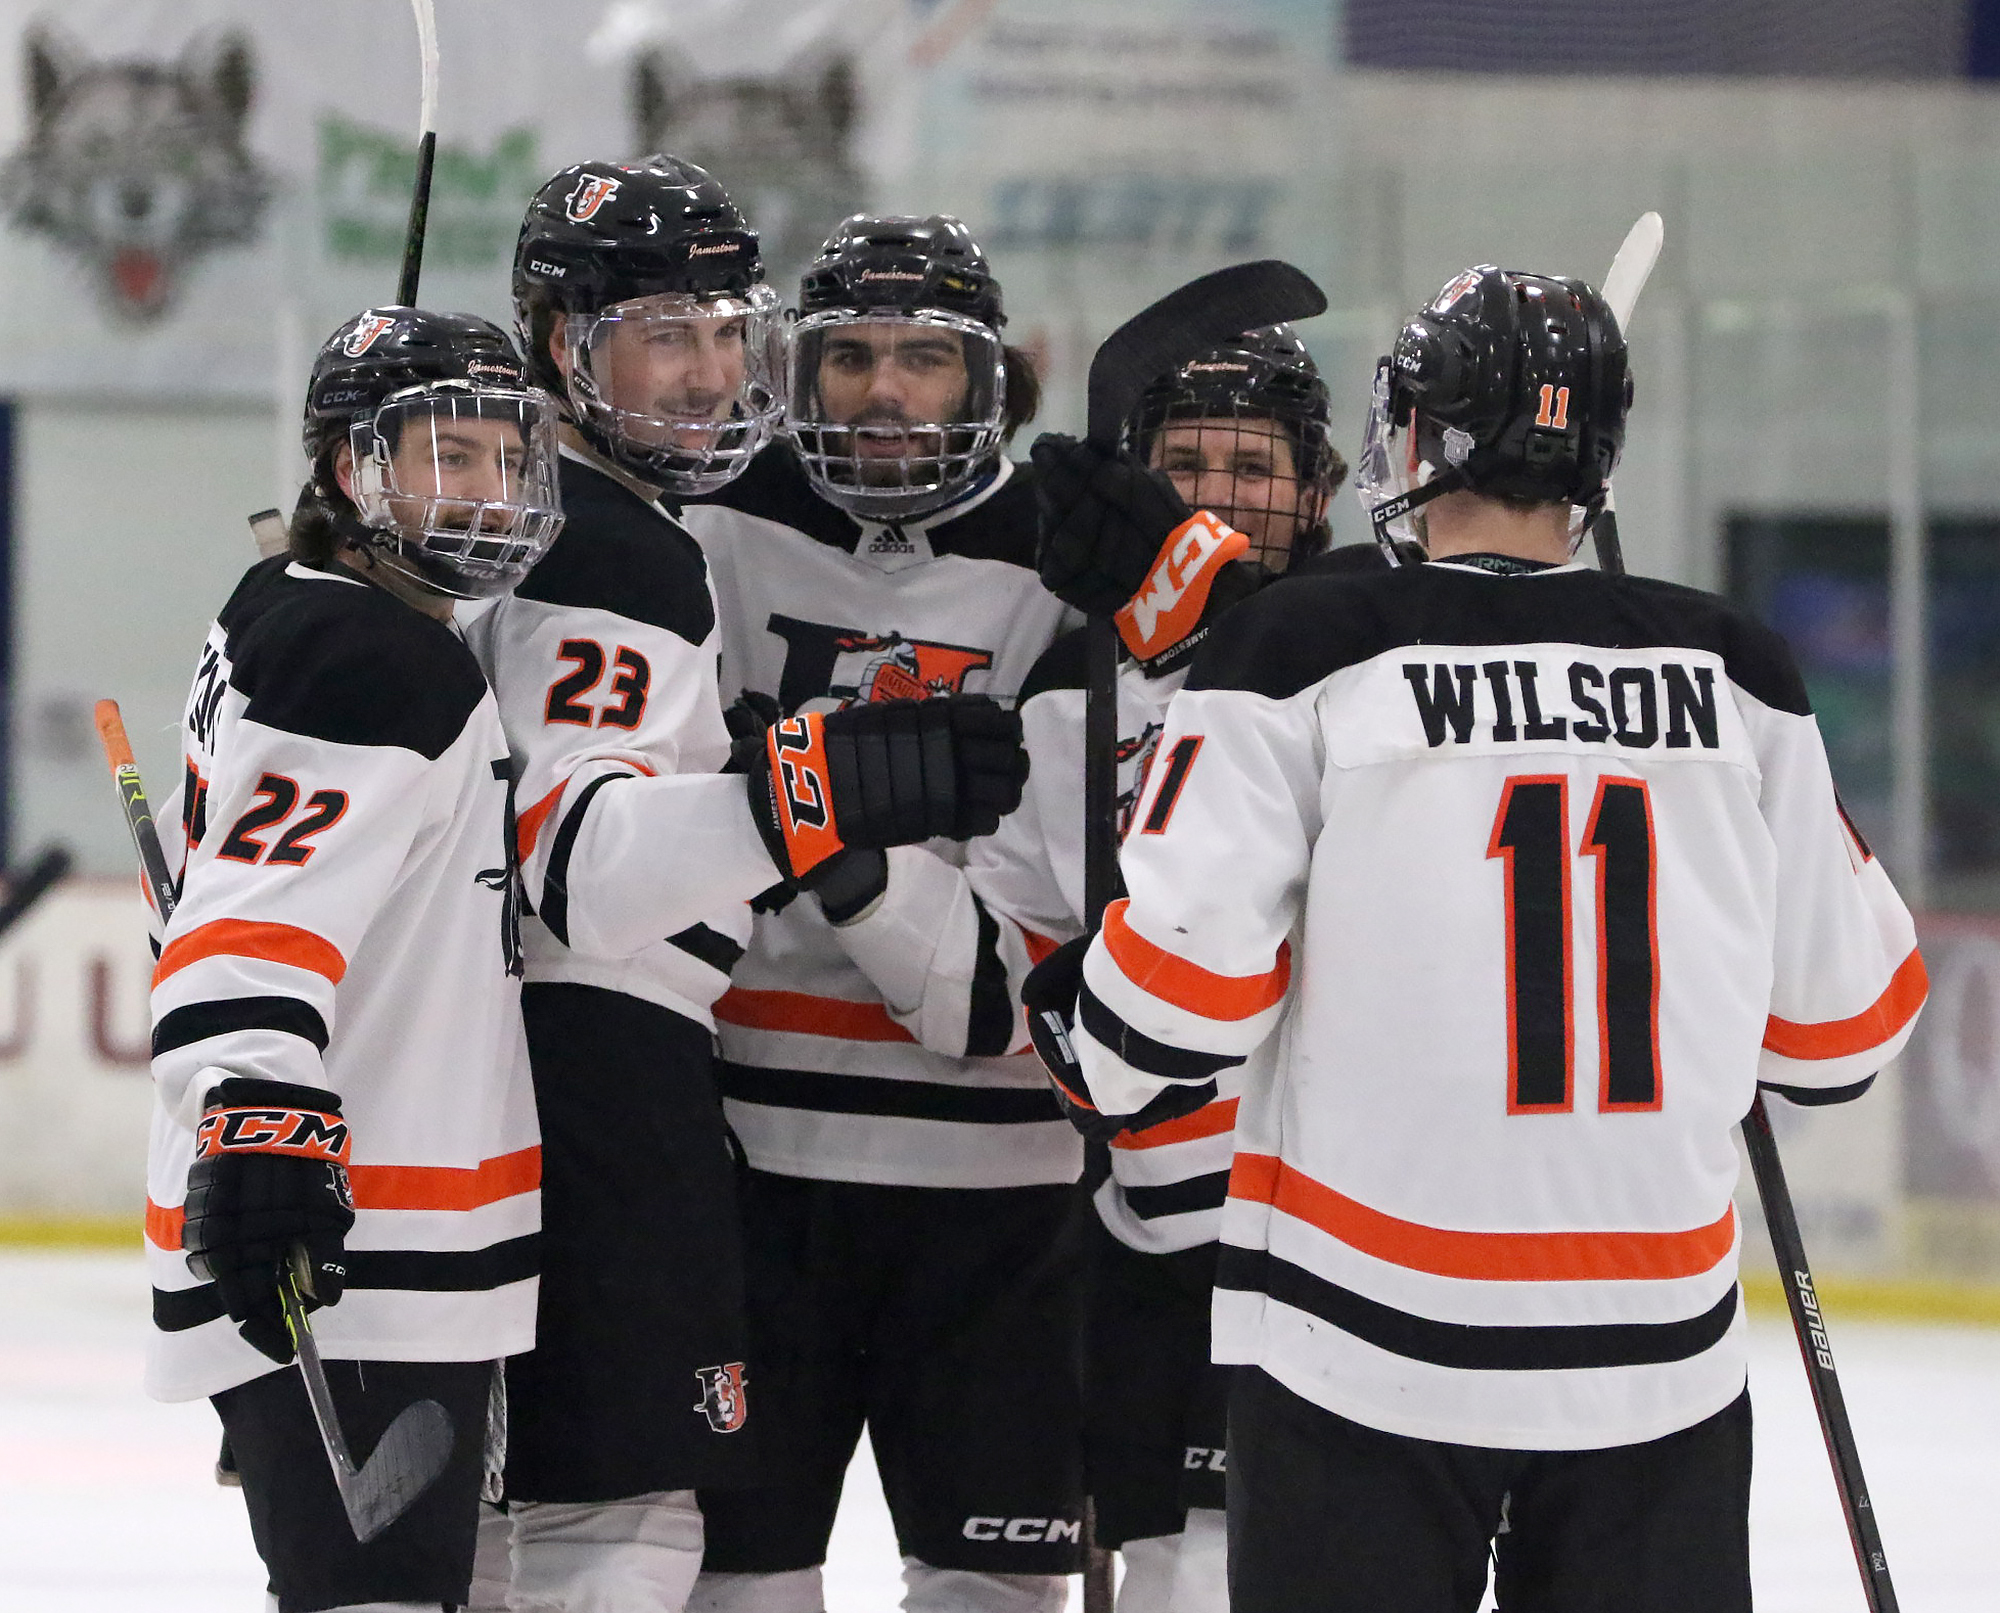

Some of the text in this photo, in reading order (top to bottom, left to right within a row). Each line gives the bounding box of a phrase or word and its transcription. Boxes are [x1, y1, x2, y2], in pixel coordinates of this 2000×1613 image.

[530, 260, 566, 278] CCM
[467, 359, 519, 377] Jamestown
[1397, 354, 1422, 373] CCM
[1535, 383, 1570, 430] 11
[1373, 498, 1410, 523] CCM
[868, 540, 915, 554] adidas
[1155, 626, 1210, 668] JAMESTOWN
[544, 637, 651, 731] 23
[1402, 660, 1720, 749] WILSON
[1122, 731, 1205, 842] 1
[215, 771, 350, 867] 22
[1486, 773, 1664, 1116] 11
[196, 1108, 350, 1161] CCM
[1794, 1270, 1835, 1371] BAUER
[962, 1517, 1081, 1544] CCM
